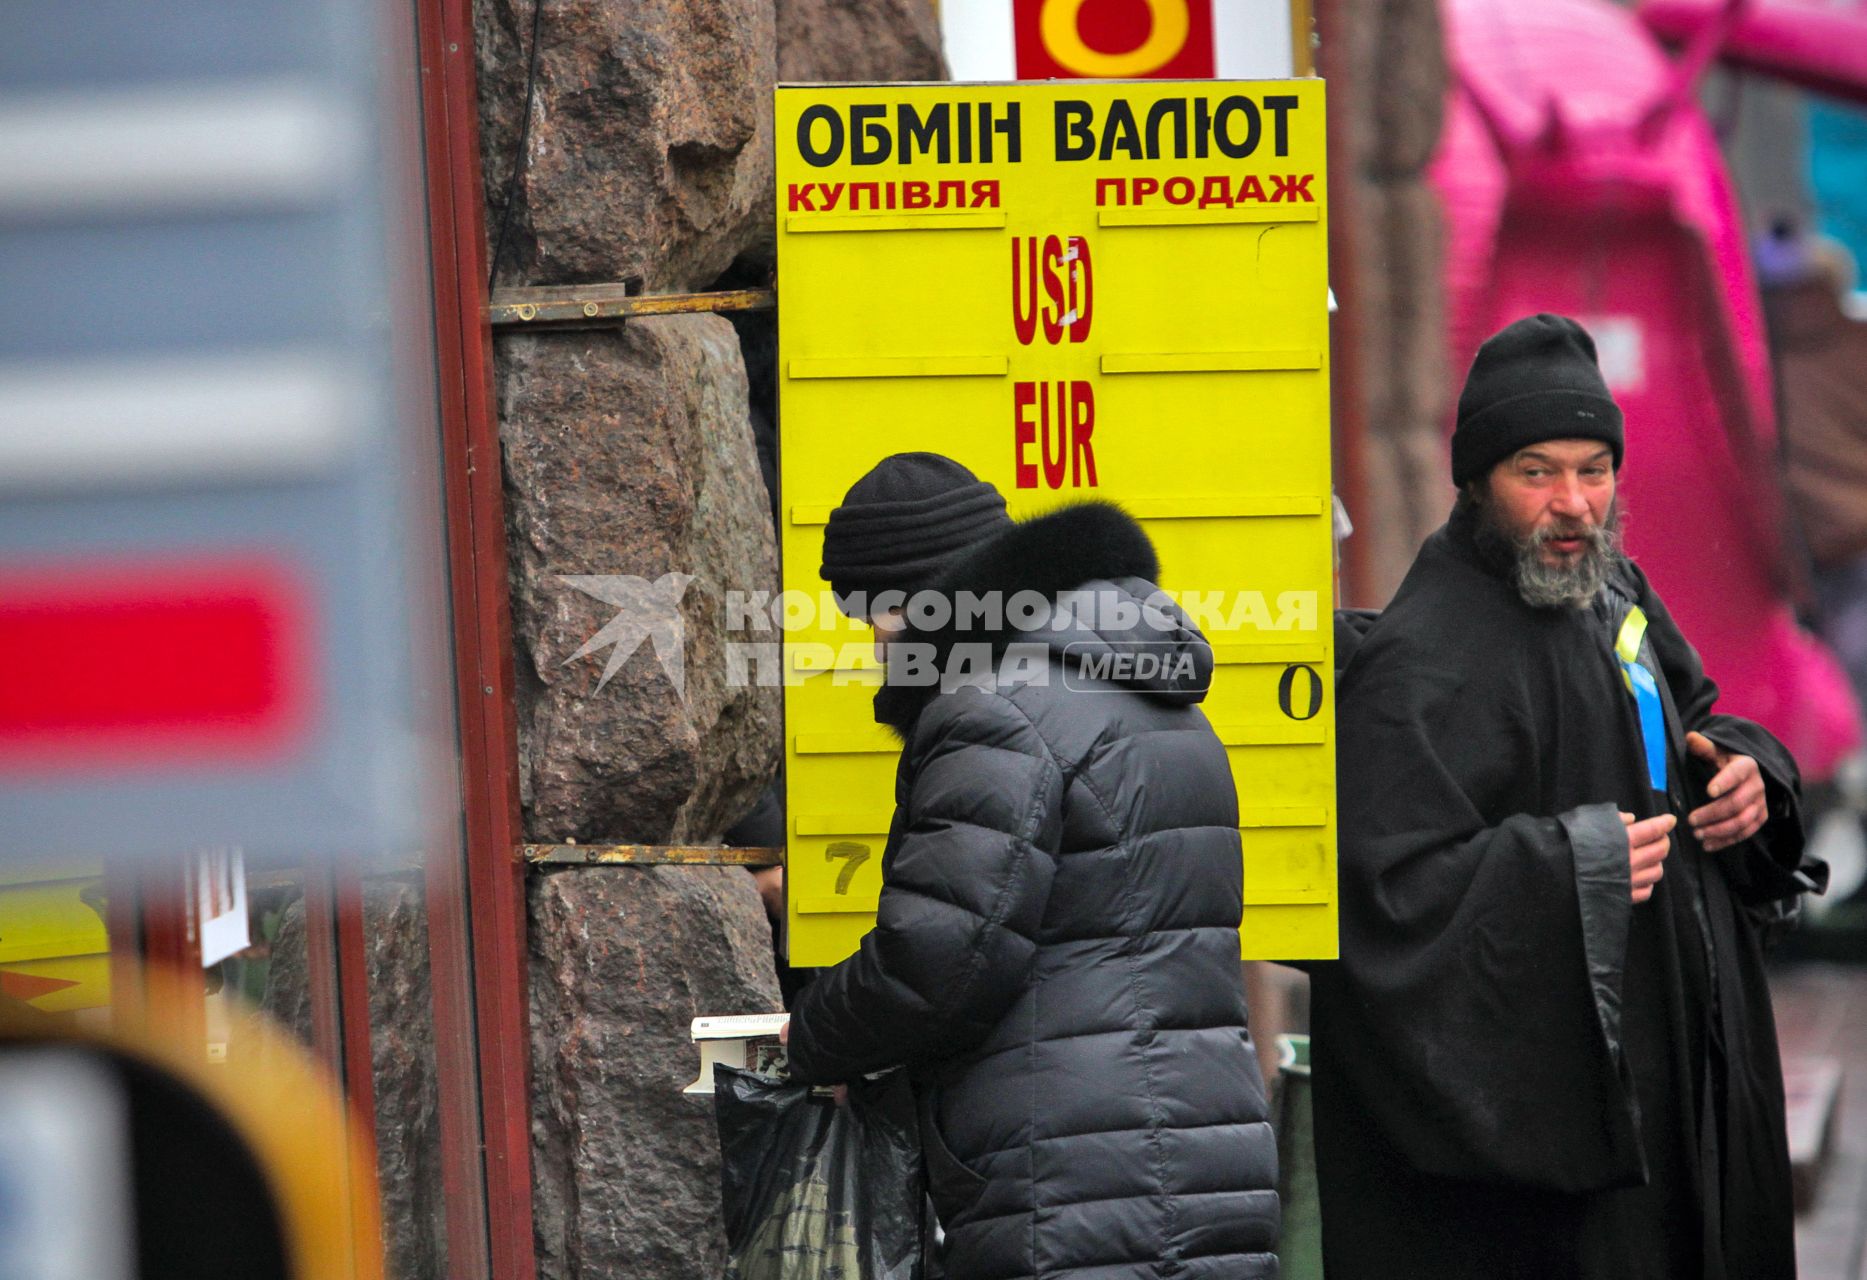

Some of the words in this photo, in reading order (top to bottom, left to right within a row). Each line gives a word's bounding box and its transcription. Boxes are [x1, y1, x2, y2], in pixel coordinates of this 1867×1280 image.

[797, 102, 1021, 168] ОБМІН
[1055, 95, 1299, 162] ВАЛЮТ
[788, 179, 1001, 212] КУПІВЛЯ
[1096, 174, 1315, 209] ПРОДАЖ
[1011, 235, 1093, 345] USD
[1014, 380, 1098, 489] EUR
